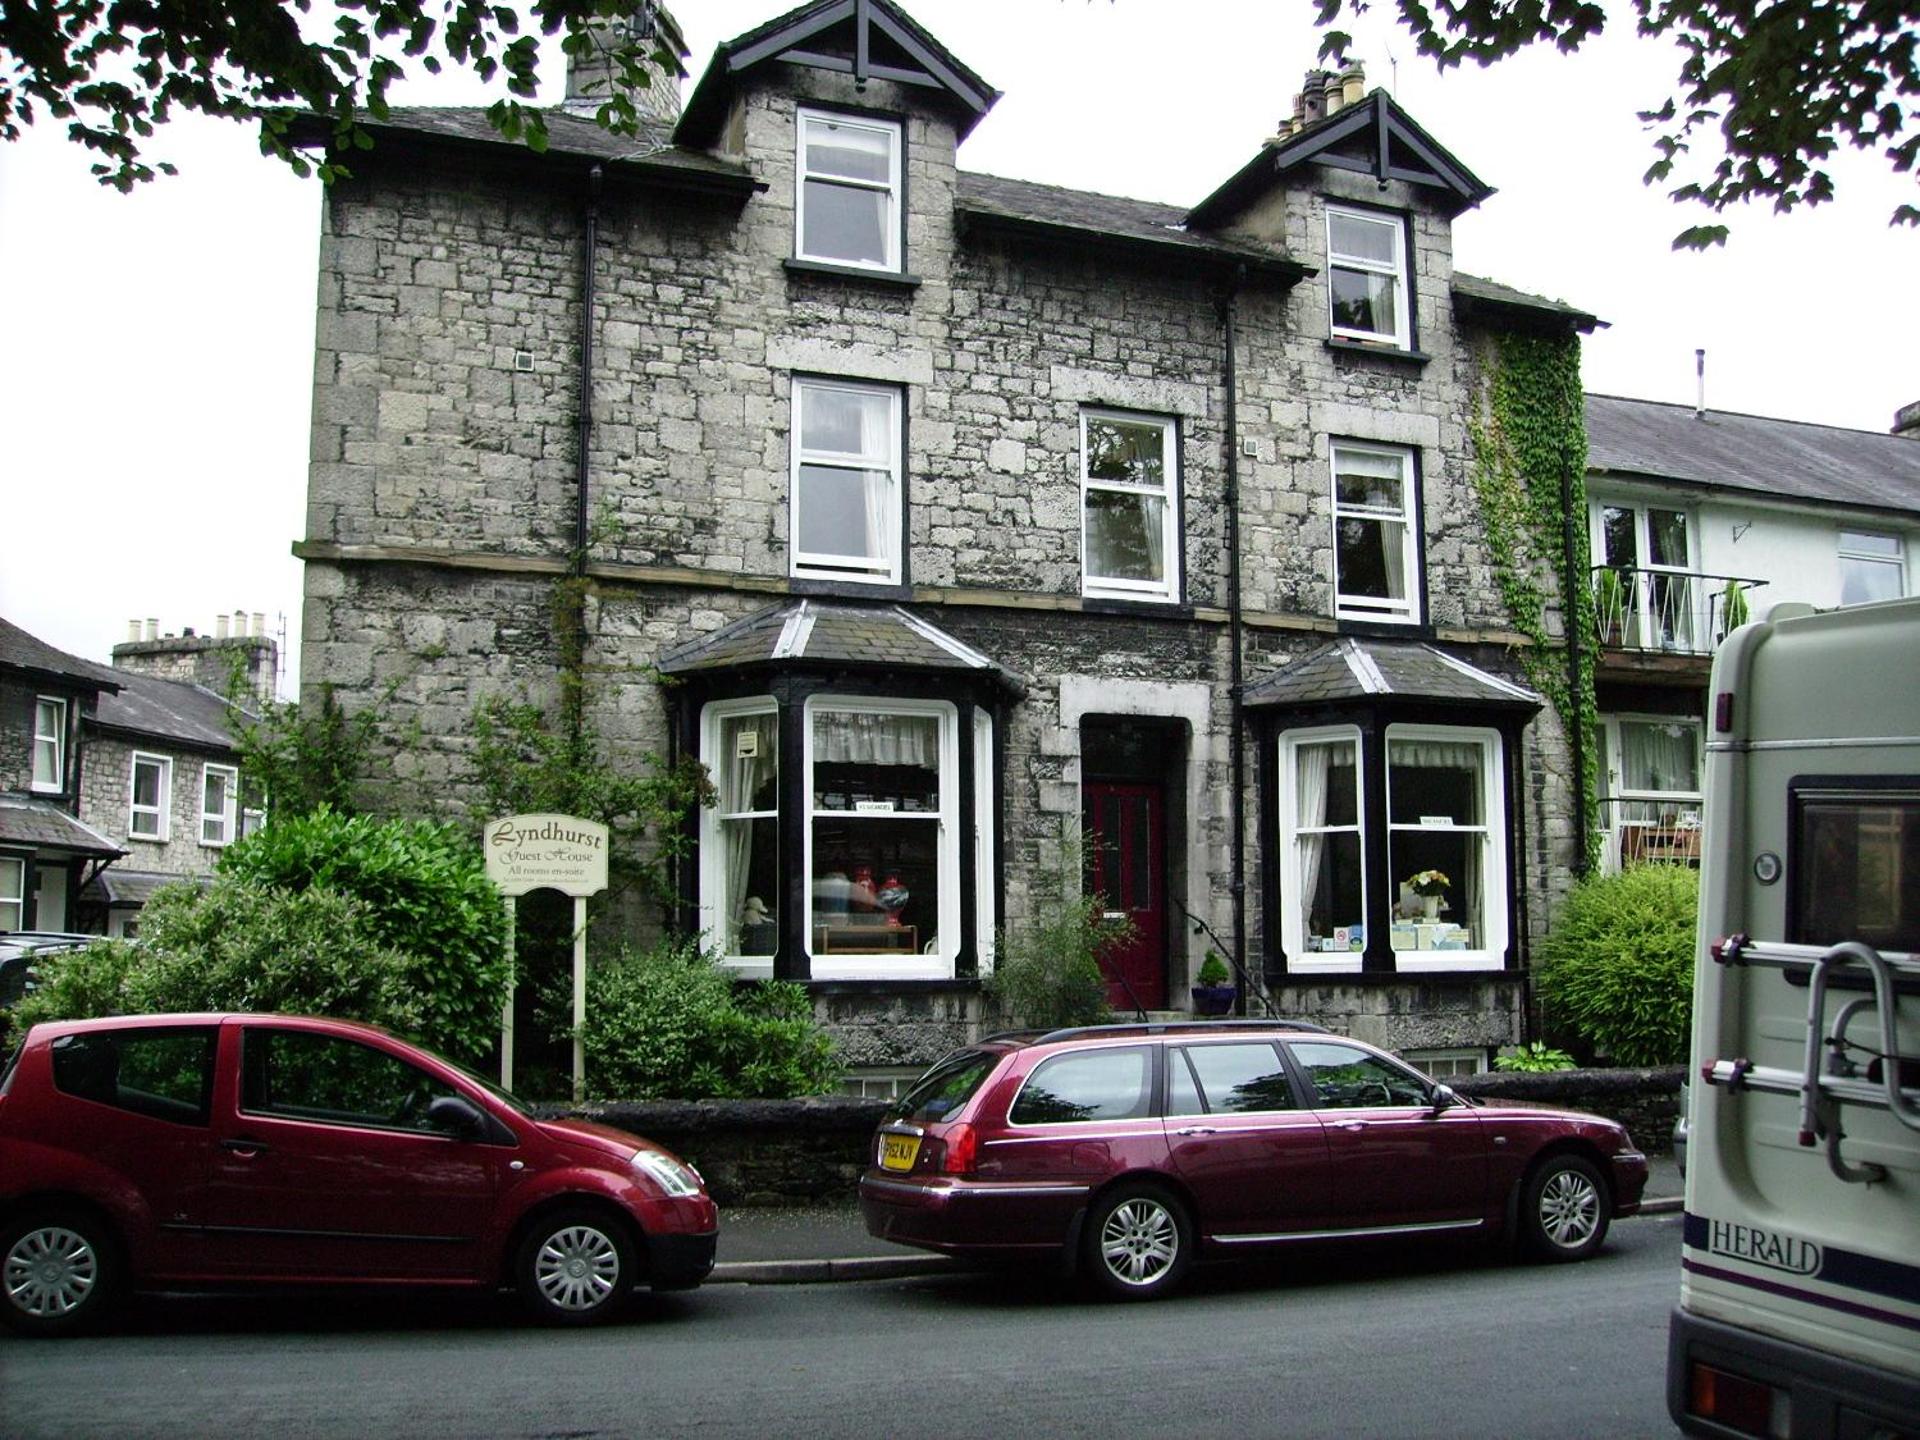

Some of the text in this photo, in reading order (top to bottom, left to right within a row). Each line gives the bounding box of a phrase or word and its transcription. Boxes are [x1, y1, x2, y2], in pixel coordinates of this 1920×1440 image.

[491, 821, 602, 849] Lyndhurst
[500, 846, 593, 865] Guest House
[509, 866, 522, 875] All
[523, 867, 550, 876] rooms
[1713, 1220, 1820, 1275] HERALD
